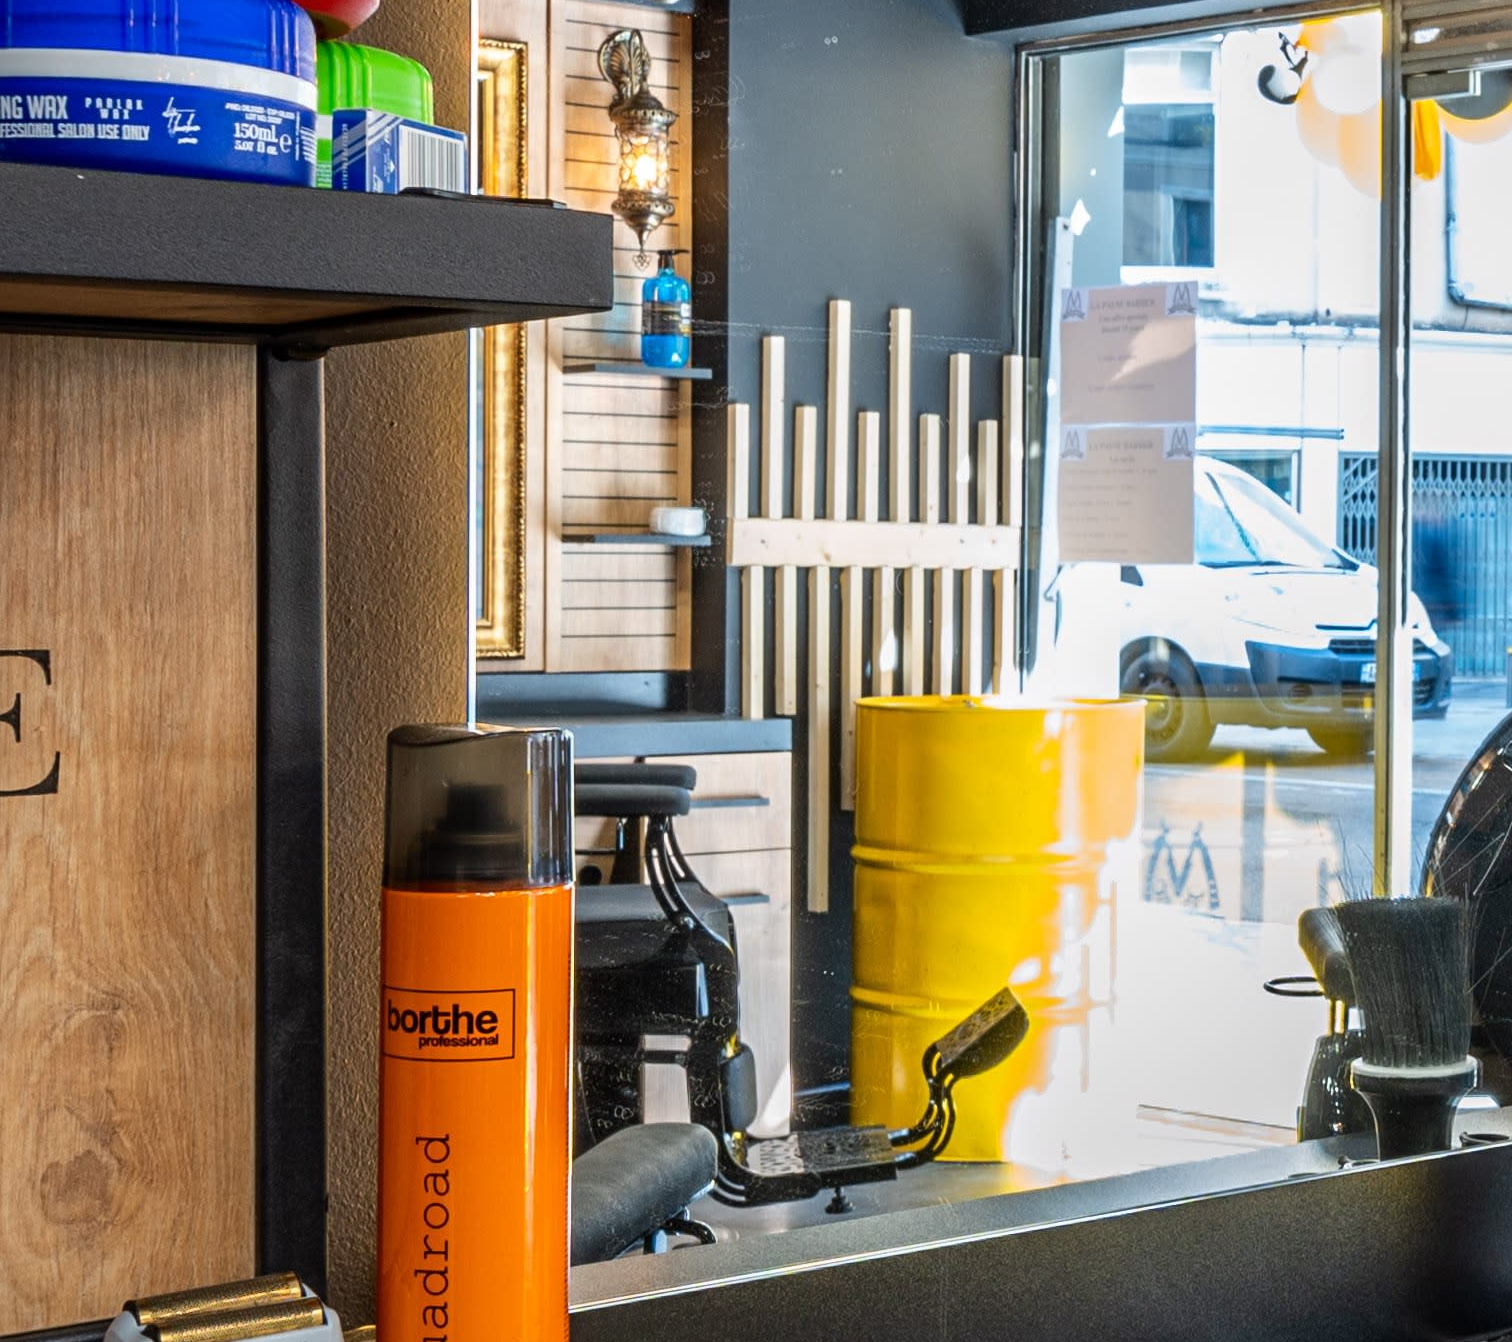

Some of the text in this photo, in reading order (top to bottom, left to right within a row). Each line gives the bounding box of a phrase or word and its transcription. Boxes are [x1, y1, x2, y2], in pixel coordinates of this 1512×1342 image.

[25, 95, 69, 120] WAX
[57, 125, 96, 140] SALON
[96, 125, 120, 141] USE
[122, 125, 151, 142] ONLY
[388, 998, 499, 1035] borthe
[418, 1033, 500, 1050] professional
